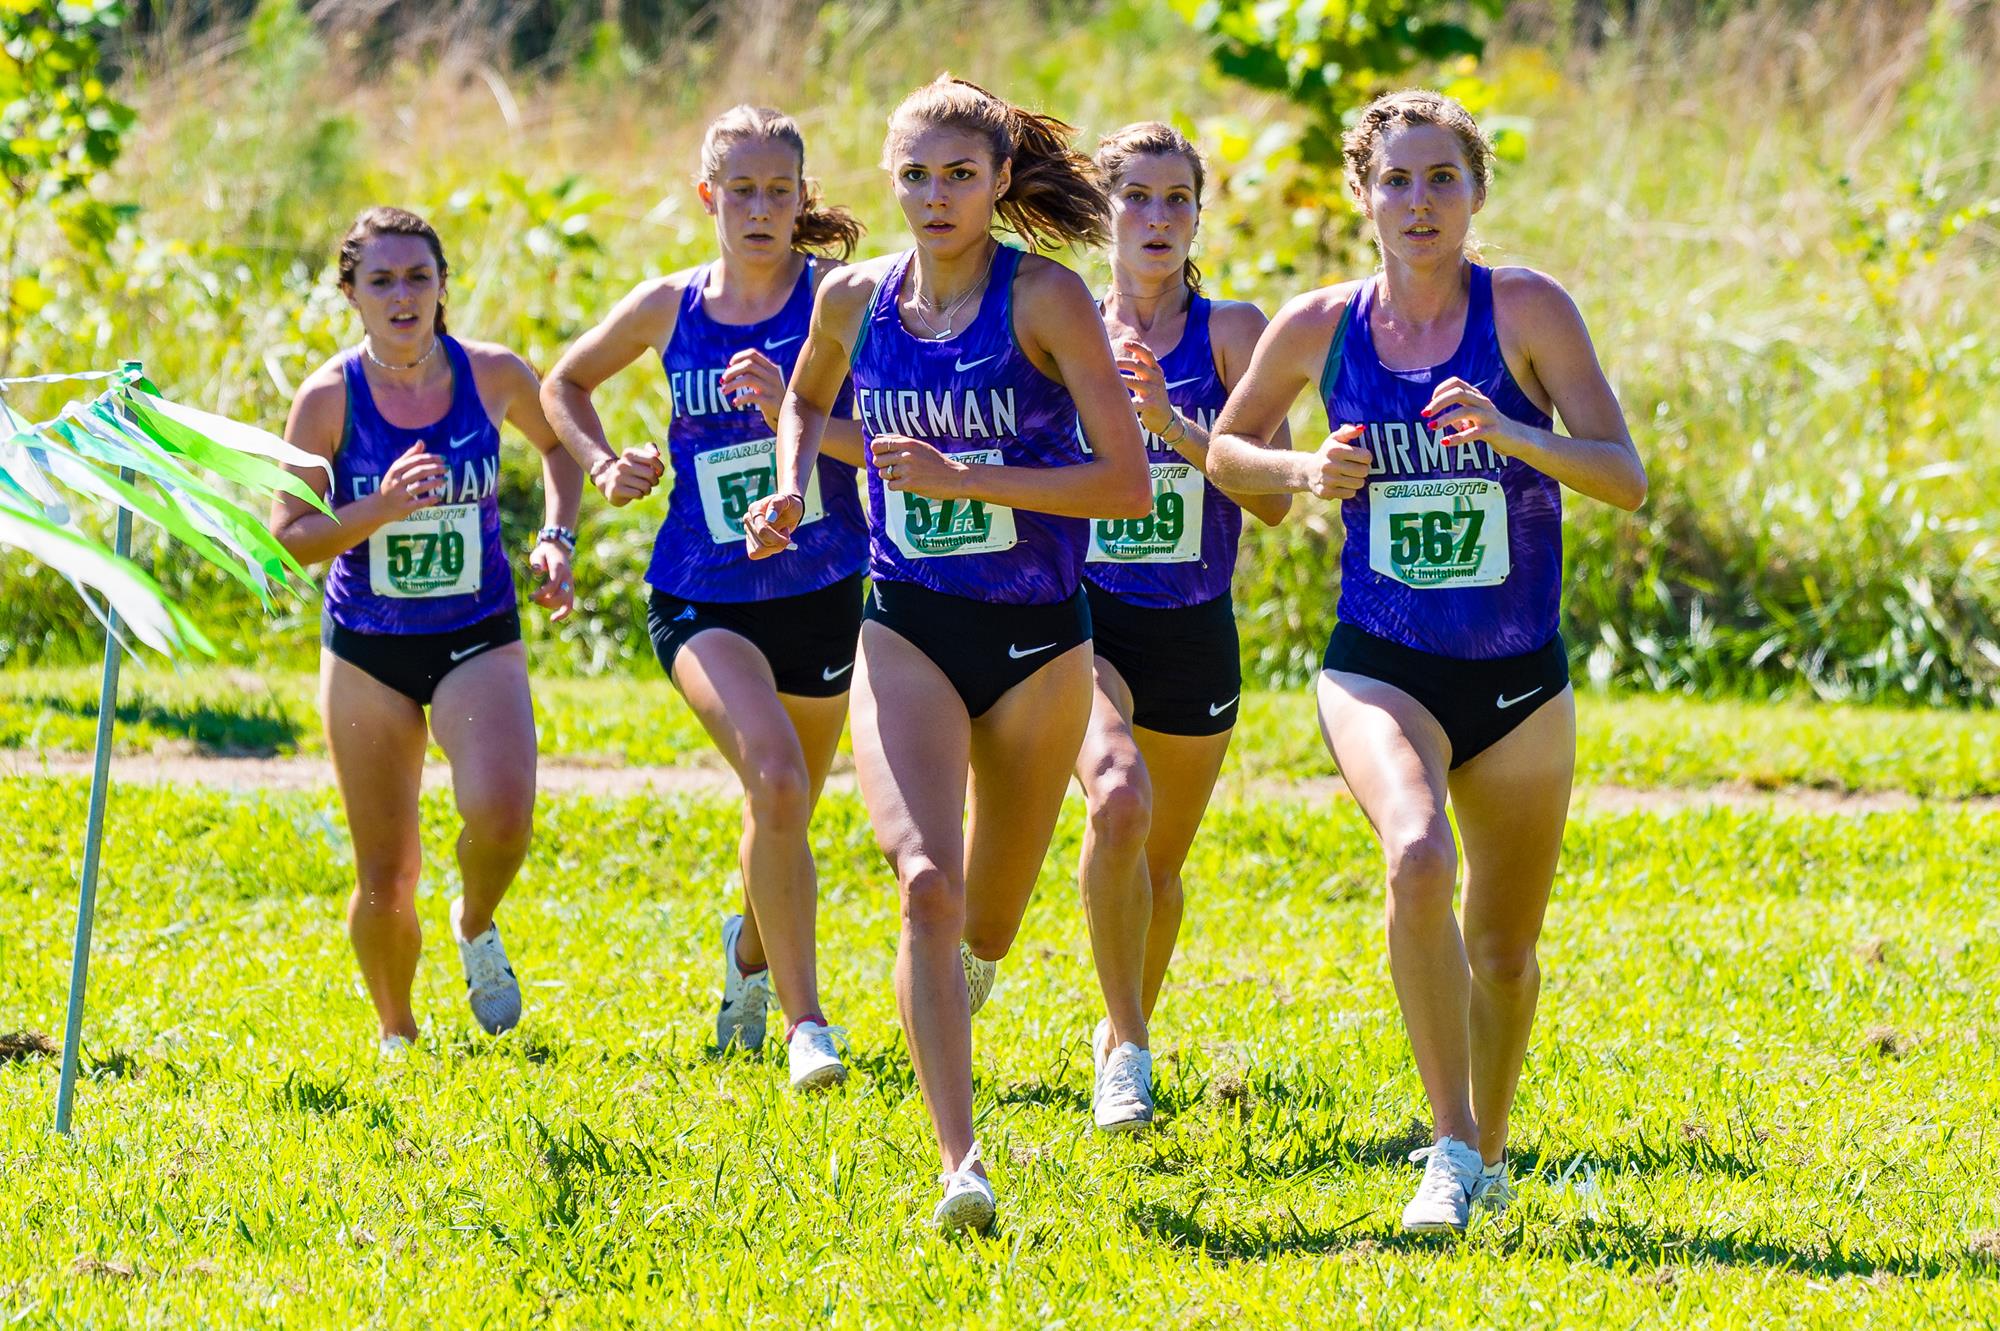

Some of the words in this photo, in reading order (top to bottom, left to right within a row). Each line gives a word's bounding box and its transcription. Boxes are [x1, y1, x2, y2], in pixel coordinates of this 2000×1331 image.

[671, 365, 786, 418] FUR
[860, 387, 1018, 438] FURMAN
[707, 441, 777, 464] CHARLO
[717, 466, 778, 520] 57
[1384, 482, 1488, 498] CHARLOTTE
[402, 507, 467, 521] ARLOTTE
[915, 538, 929, 549] XC
[931, 534, 987, 548] Invitational
[1389, 510, 1485, 565] 567
[387, 531, 465, 577] 570
[1105, 544, 1118, 554] XC
[1121, 544, 1175, 555] Invitational
[1401, 567, 1415, 579] XC
[1418, 565, 1477, 579] Invitational
